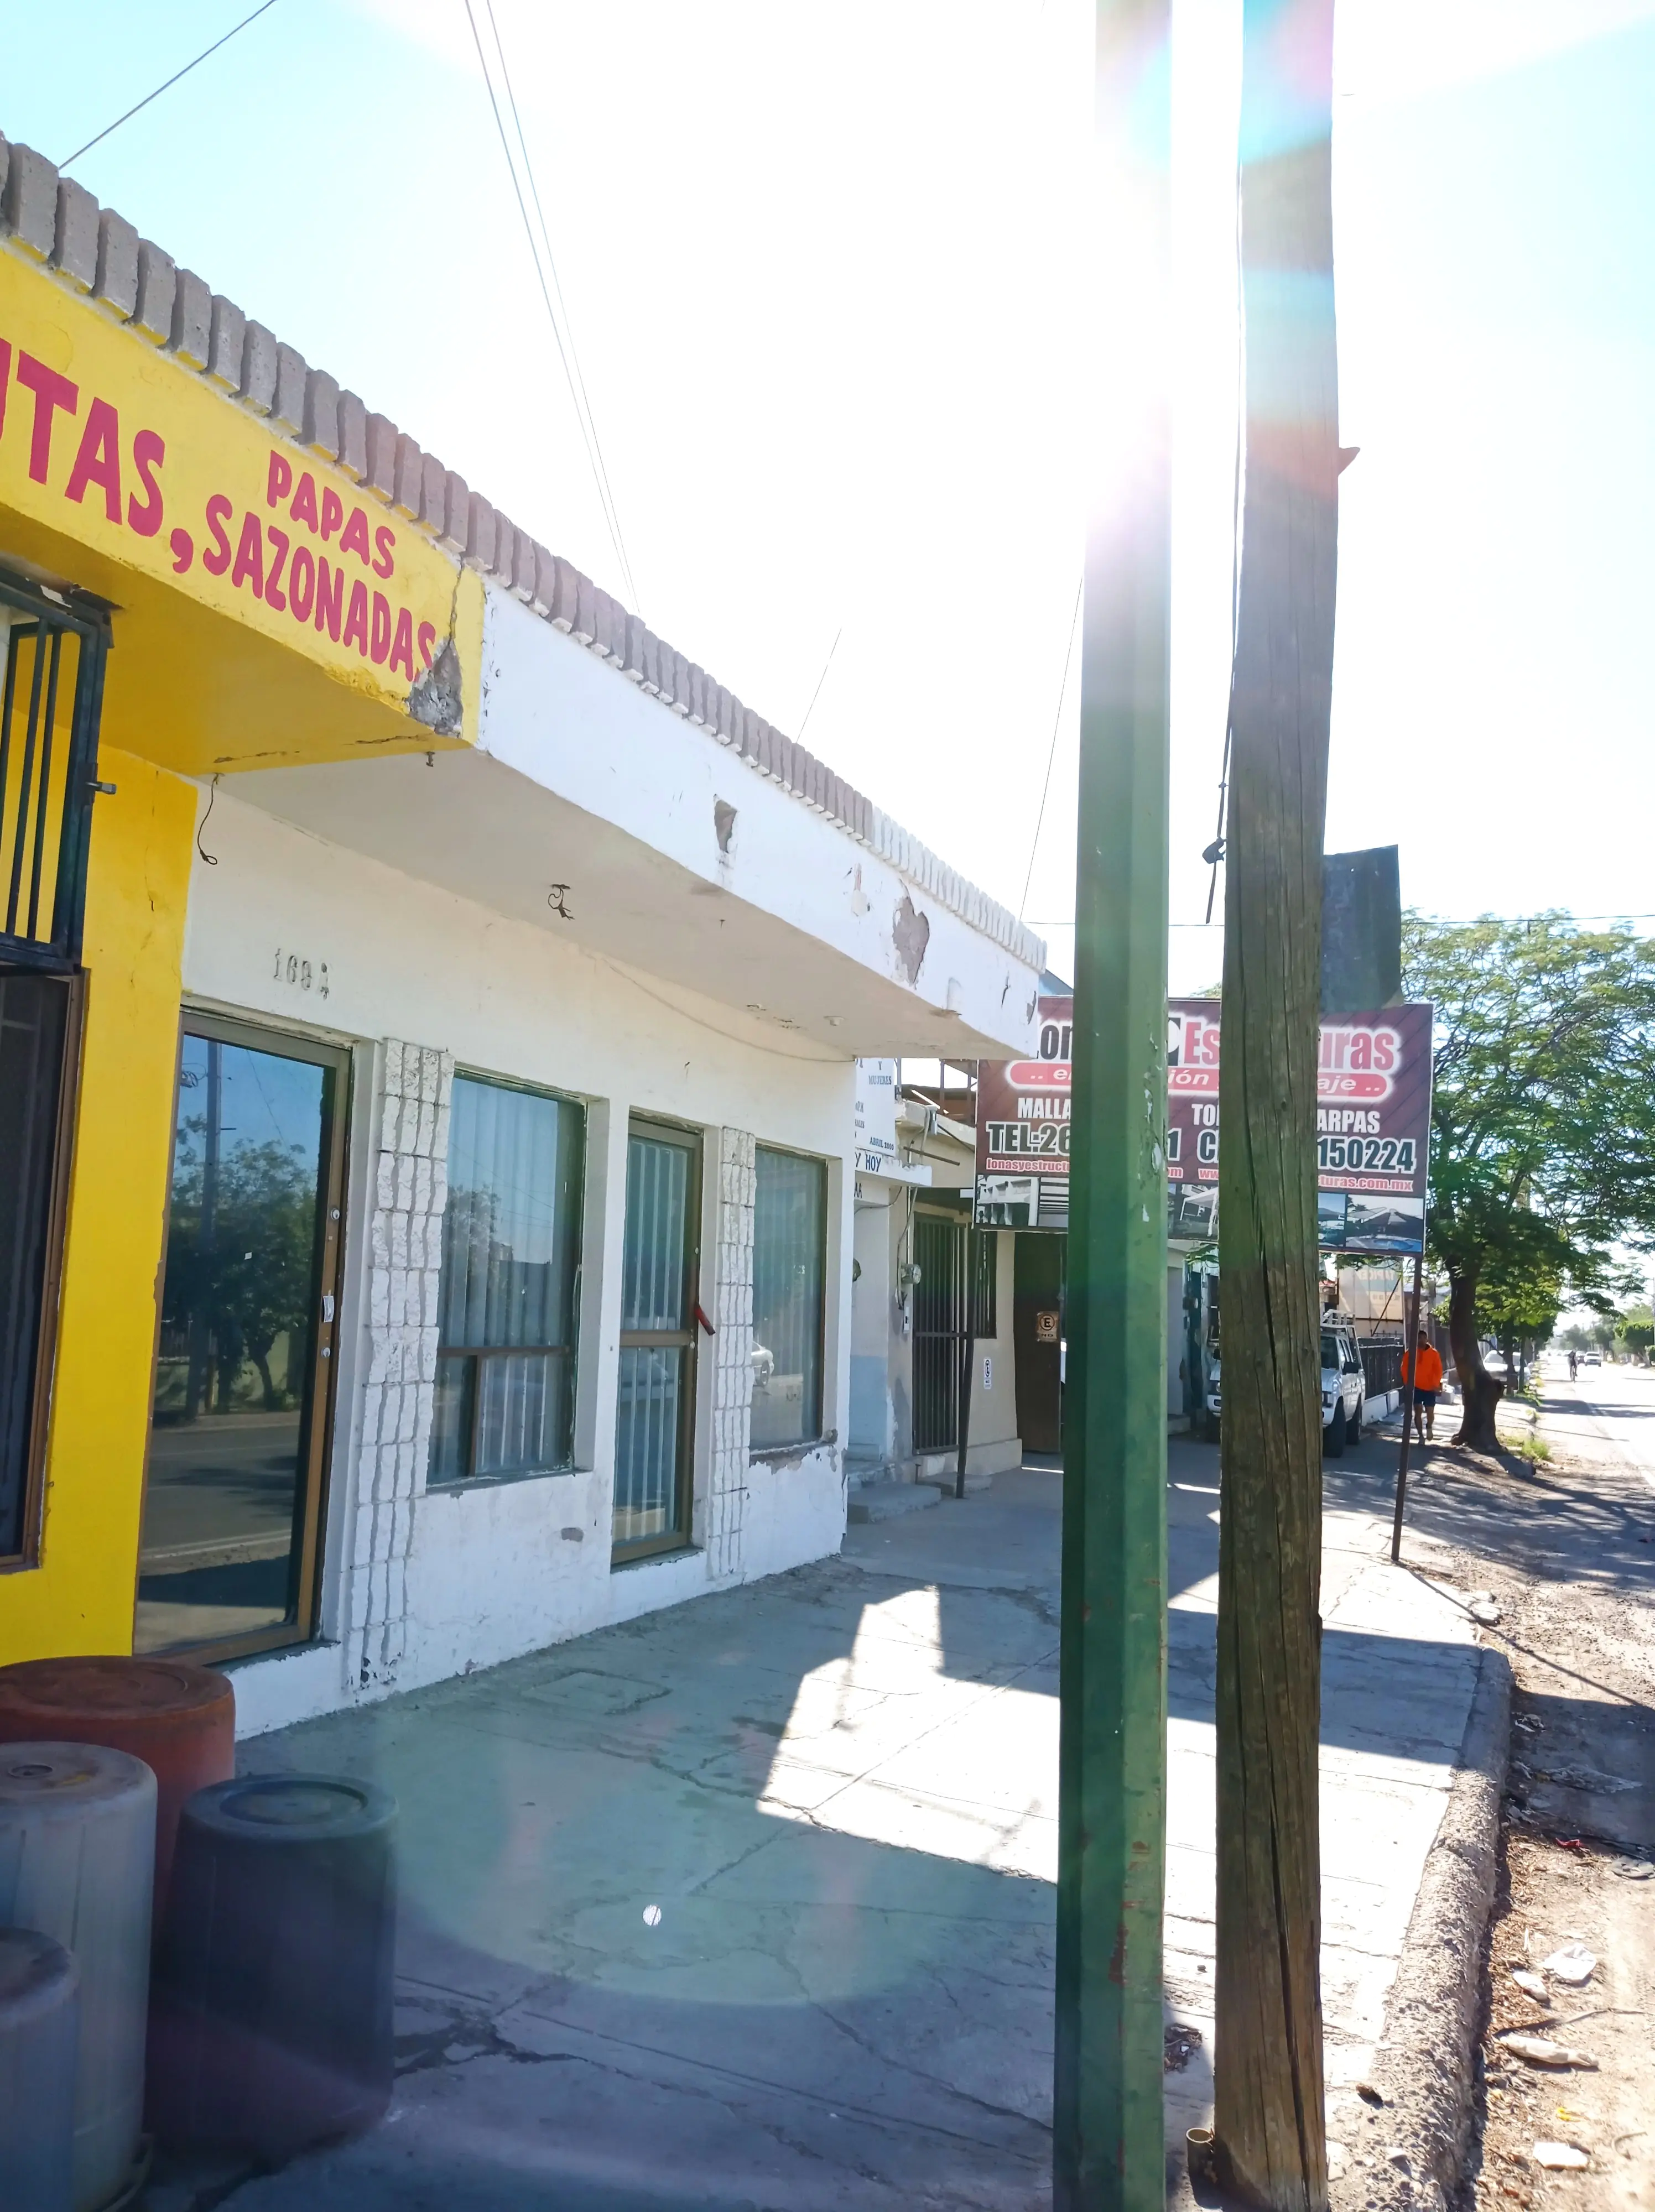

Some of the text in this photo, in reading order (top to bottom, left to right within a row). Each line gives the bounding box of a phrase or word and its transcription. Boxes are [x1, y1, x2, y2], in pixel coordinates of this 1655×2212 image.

[0, 338, 194, 574] TAS,
[267, 450, 396, 579] PAPAS
[203, 494, 436, 682] SAZONADAS
[1184, 1022, 1220, 1065] Es
[1318, 1032, 1394, 1071] uras
[868, 1075, 892, 1085] MUJERES
[1168, 1070, 1209, 1085] ión
[1318, 1076, 1356, 1093] aje
[1018, 1097, 1380, 1134] MALLA TO ARPAS
[870, 1137, 883, 1149] ABRIL
[986, 1121, 1070, 1156] TEL:26
[1318, 1135, 1416, 1174] 150224
[865, 1154, 881, 1172] HOY
[1318, 1175, 1413, 1192] turas.com.mx
